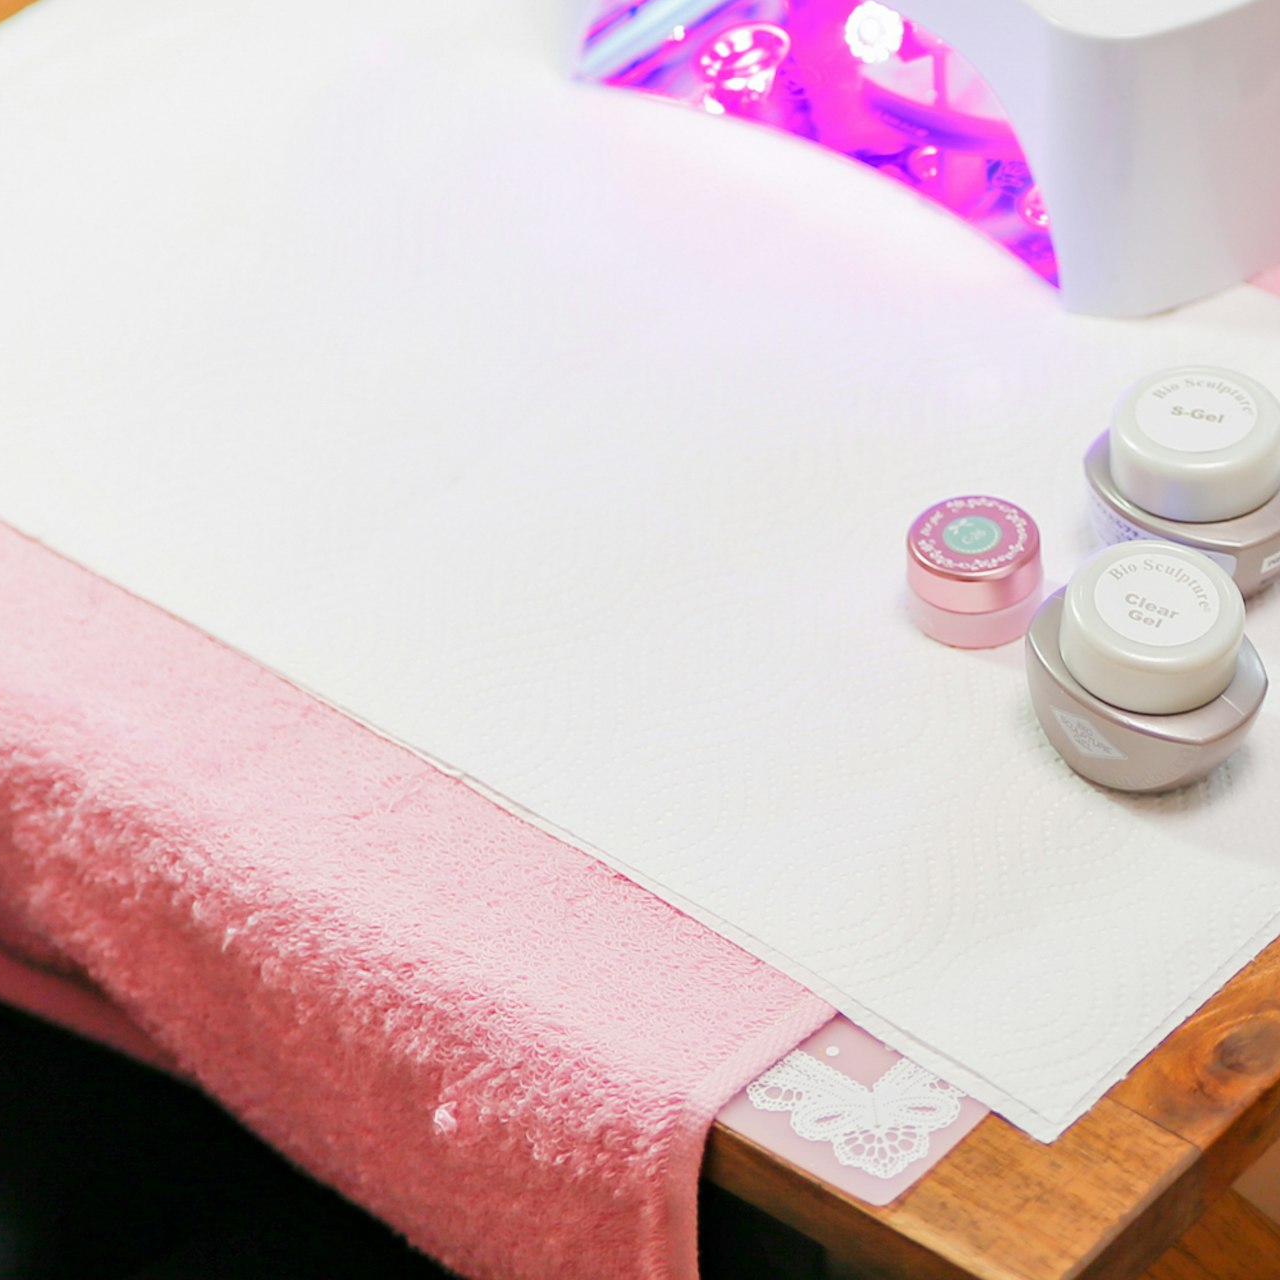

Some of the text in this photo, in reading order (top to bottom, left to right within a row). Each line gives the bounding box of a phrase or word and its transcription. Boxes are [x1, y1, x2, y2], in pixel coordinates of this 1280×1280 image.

[1152, 383, 1180, 401] Bio
[1170, 406, 1224, 424] S-Gel
[1108, 563, 1137, 581] Bio
[1125, 593, 1180, 619] Clear
[1128, 609, 1162, 629] Gel
